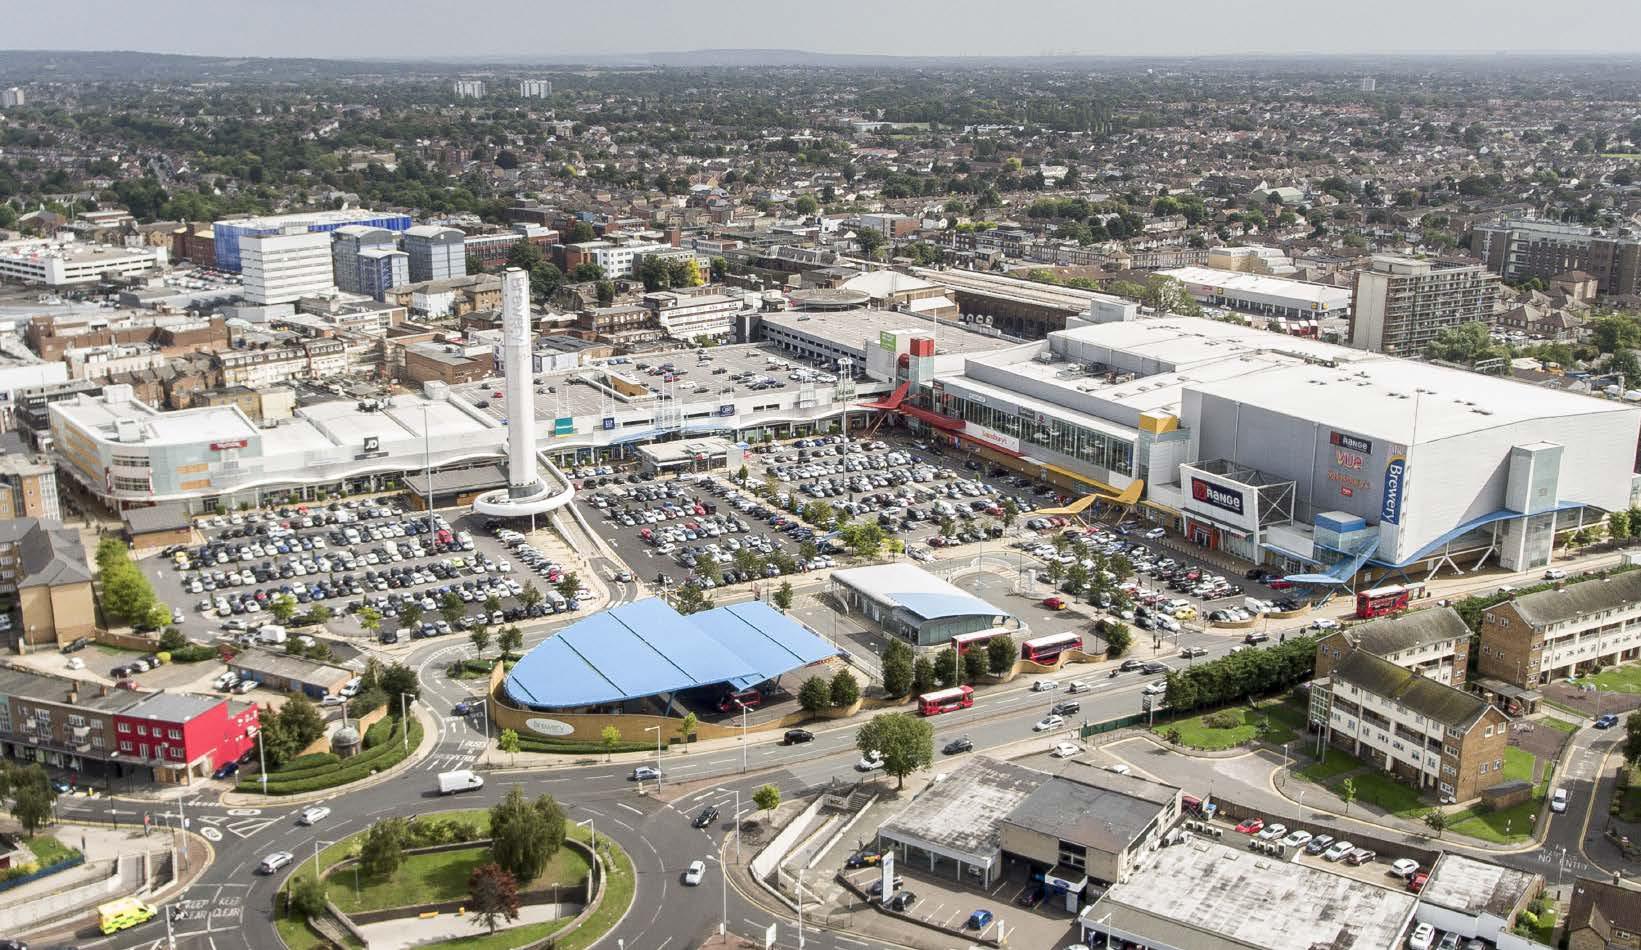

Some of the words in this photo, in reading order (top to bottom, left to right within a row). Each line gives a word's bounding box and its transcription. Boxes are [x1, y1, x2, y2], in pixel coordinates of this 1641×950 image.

[365, 440, 378, 449] JD
[1382, 464, 1403, 523] Brewery
[1538, 854, 1552, 863] NO
[185, 900, 209, 909] KEEP
[220, 897, 241, 905] KEEP
[213, 907, 241, 917] CLEAR
